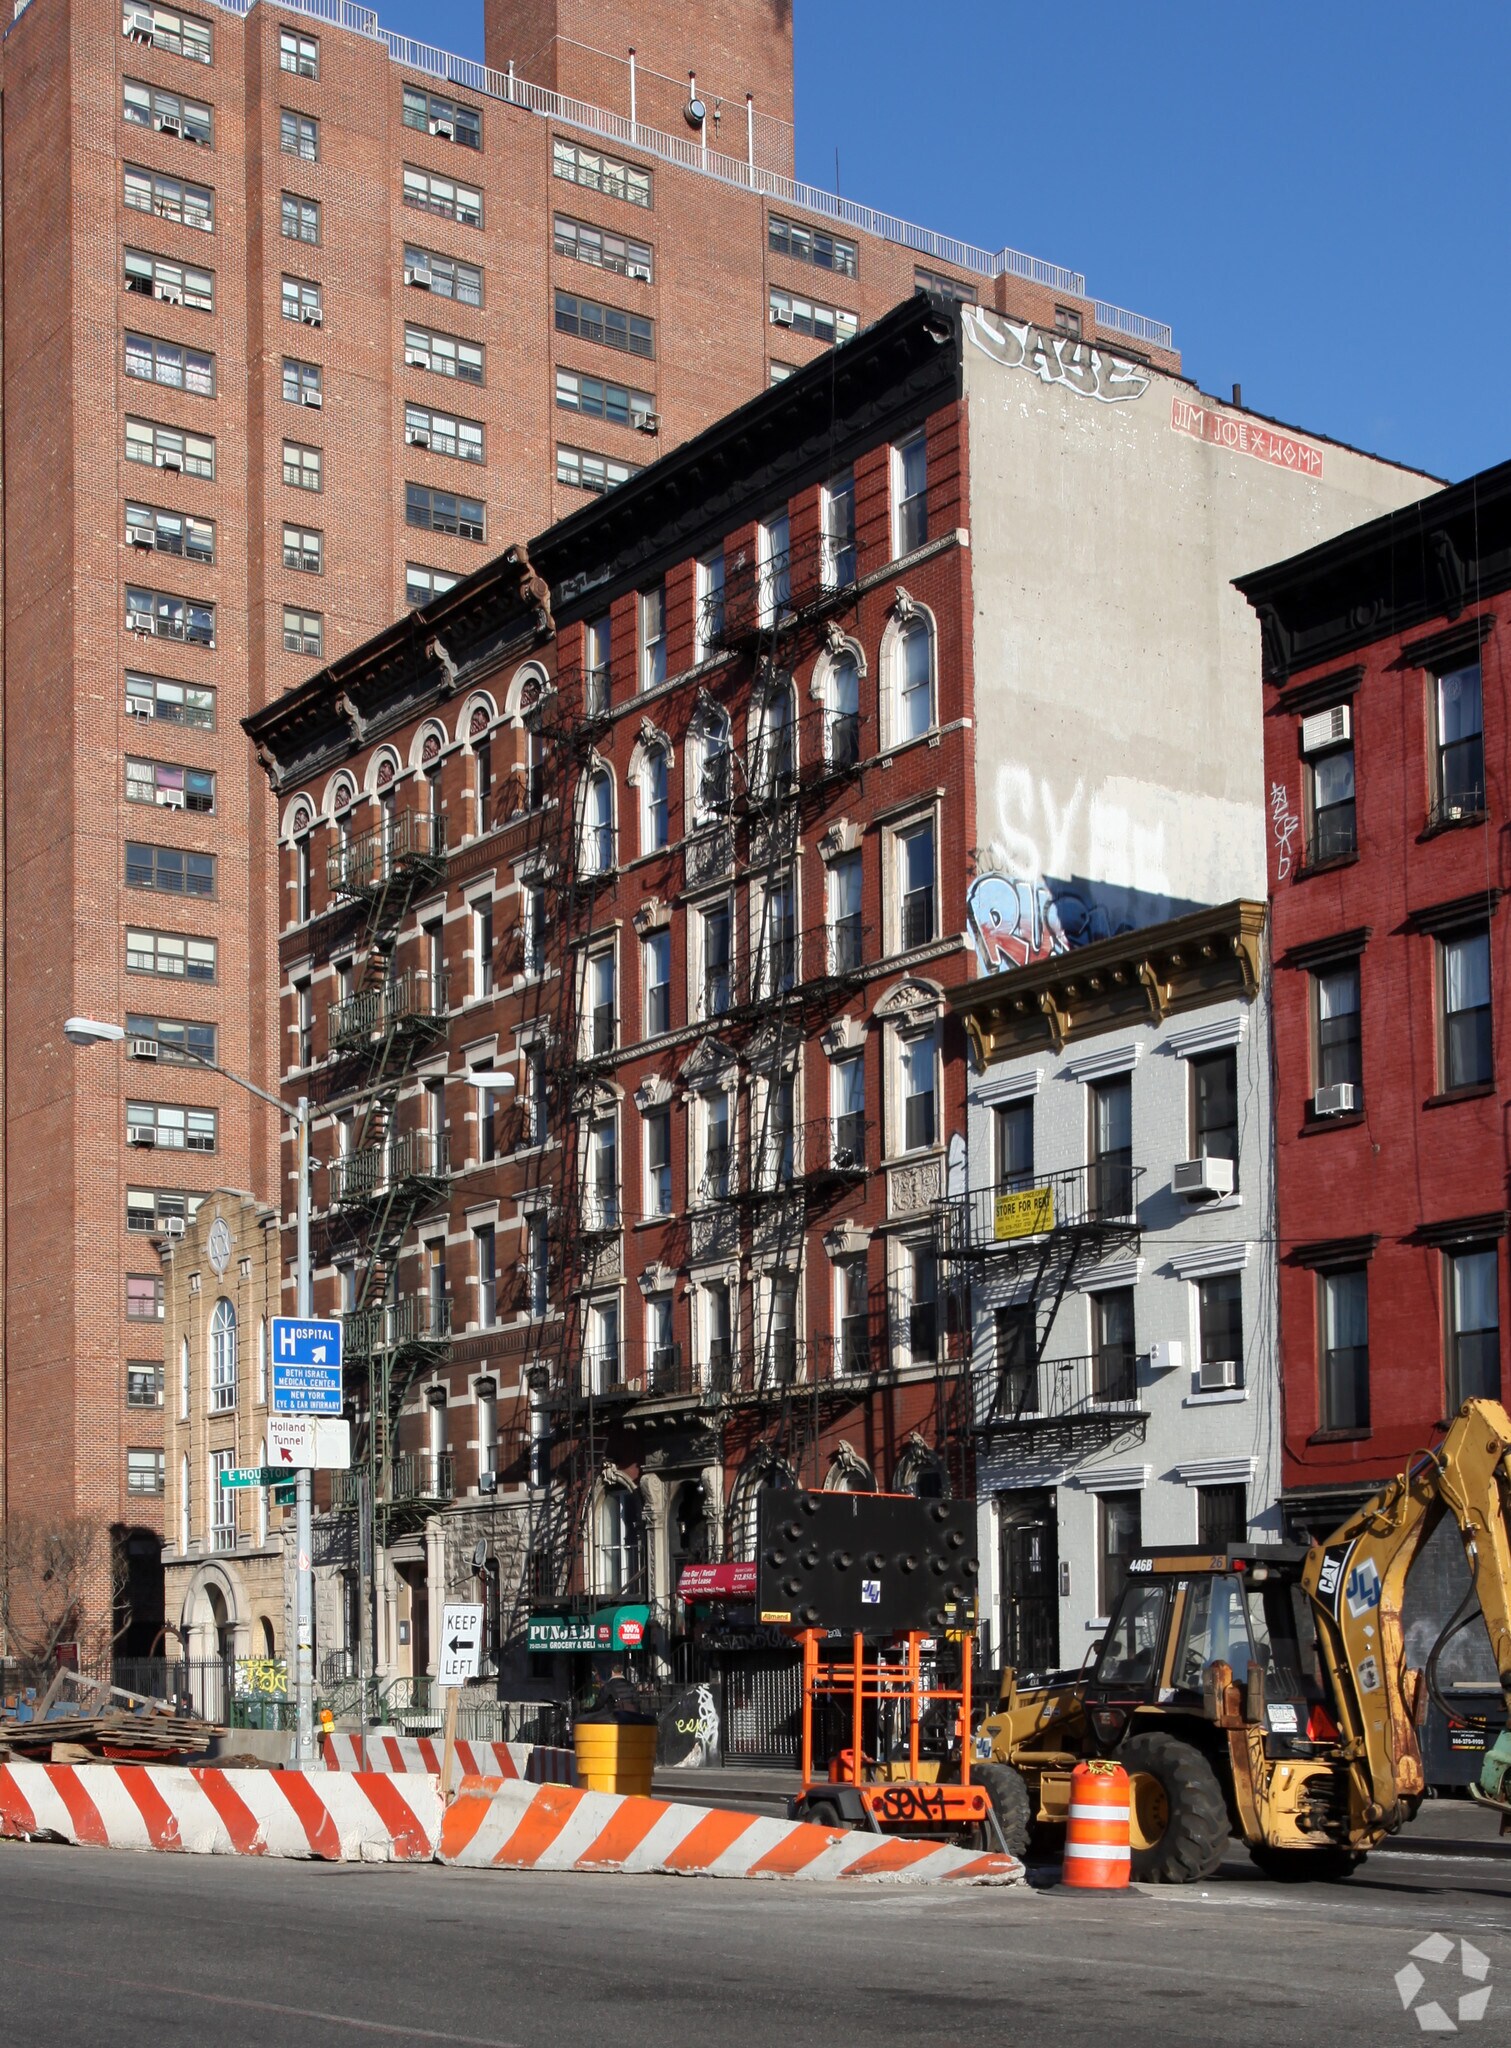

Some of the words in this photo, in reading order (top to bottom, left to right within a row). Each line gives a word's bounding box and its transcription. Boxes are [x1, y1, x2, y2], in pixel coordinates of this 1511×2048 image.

[1174, 401, 1204, 434] JIM
[1214, 416, 1247, 450] JOE
[1269, 436, 1321, 471] WOMP
[996, 1203, 1016, 1217] STORE
[1018, 1199, 1032, 1212] FOR
[280, 1327, 334, 1356] HOSPITAL
[285, 1369, 303, 1377] BETH
[305, 1370, 329, 1378] ISRAEL
[278, 1378, 308, 1386] MEDICAL
[310, 1379, 336, 1387] CENTER
[290, 1391, 305, 1399] NEW
[307, 1391, 325, 1399] YORK
[276, 1400, 287, 1408] EYE
[290, 1400, 295, 1408] &
[296, 1400, 308, 1408] EAR
[310, 1401, 339, 1410] INFIRMARY
[270, 1421, 306, 1432] Holland
[273, 1435, 304, 1445] Tunnel
[228, 1471, 235, 1481] E
[240, 1467, 289, 1480] HOUSTON
[1129, 1559, 1153, 1573] 446B
[1210, 1556, 1223, 1569] 26
[702, 1569, 717, 1577] Retail
[1318, 1556, 1341, 1595] CAT
[863, 1580, 880, 1603] JLJ
[1346, 1567, 1381, 1608] JLJ
[447, 1615, 477, 1630] KEEP
[530, 1625, 596, 1640] PUNJABI
[549, 1641, 576, 1649] GROCERY
[582, 1641, 596, 1649] DELI
[445, 1660, 473, 1675] LEFT
[976, 1738, 991, 1758] JLJ
